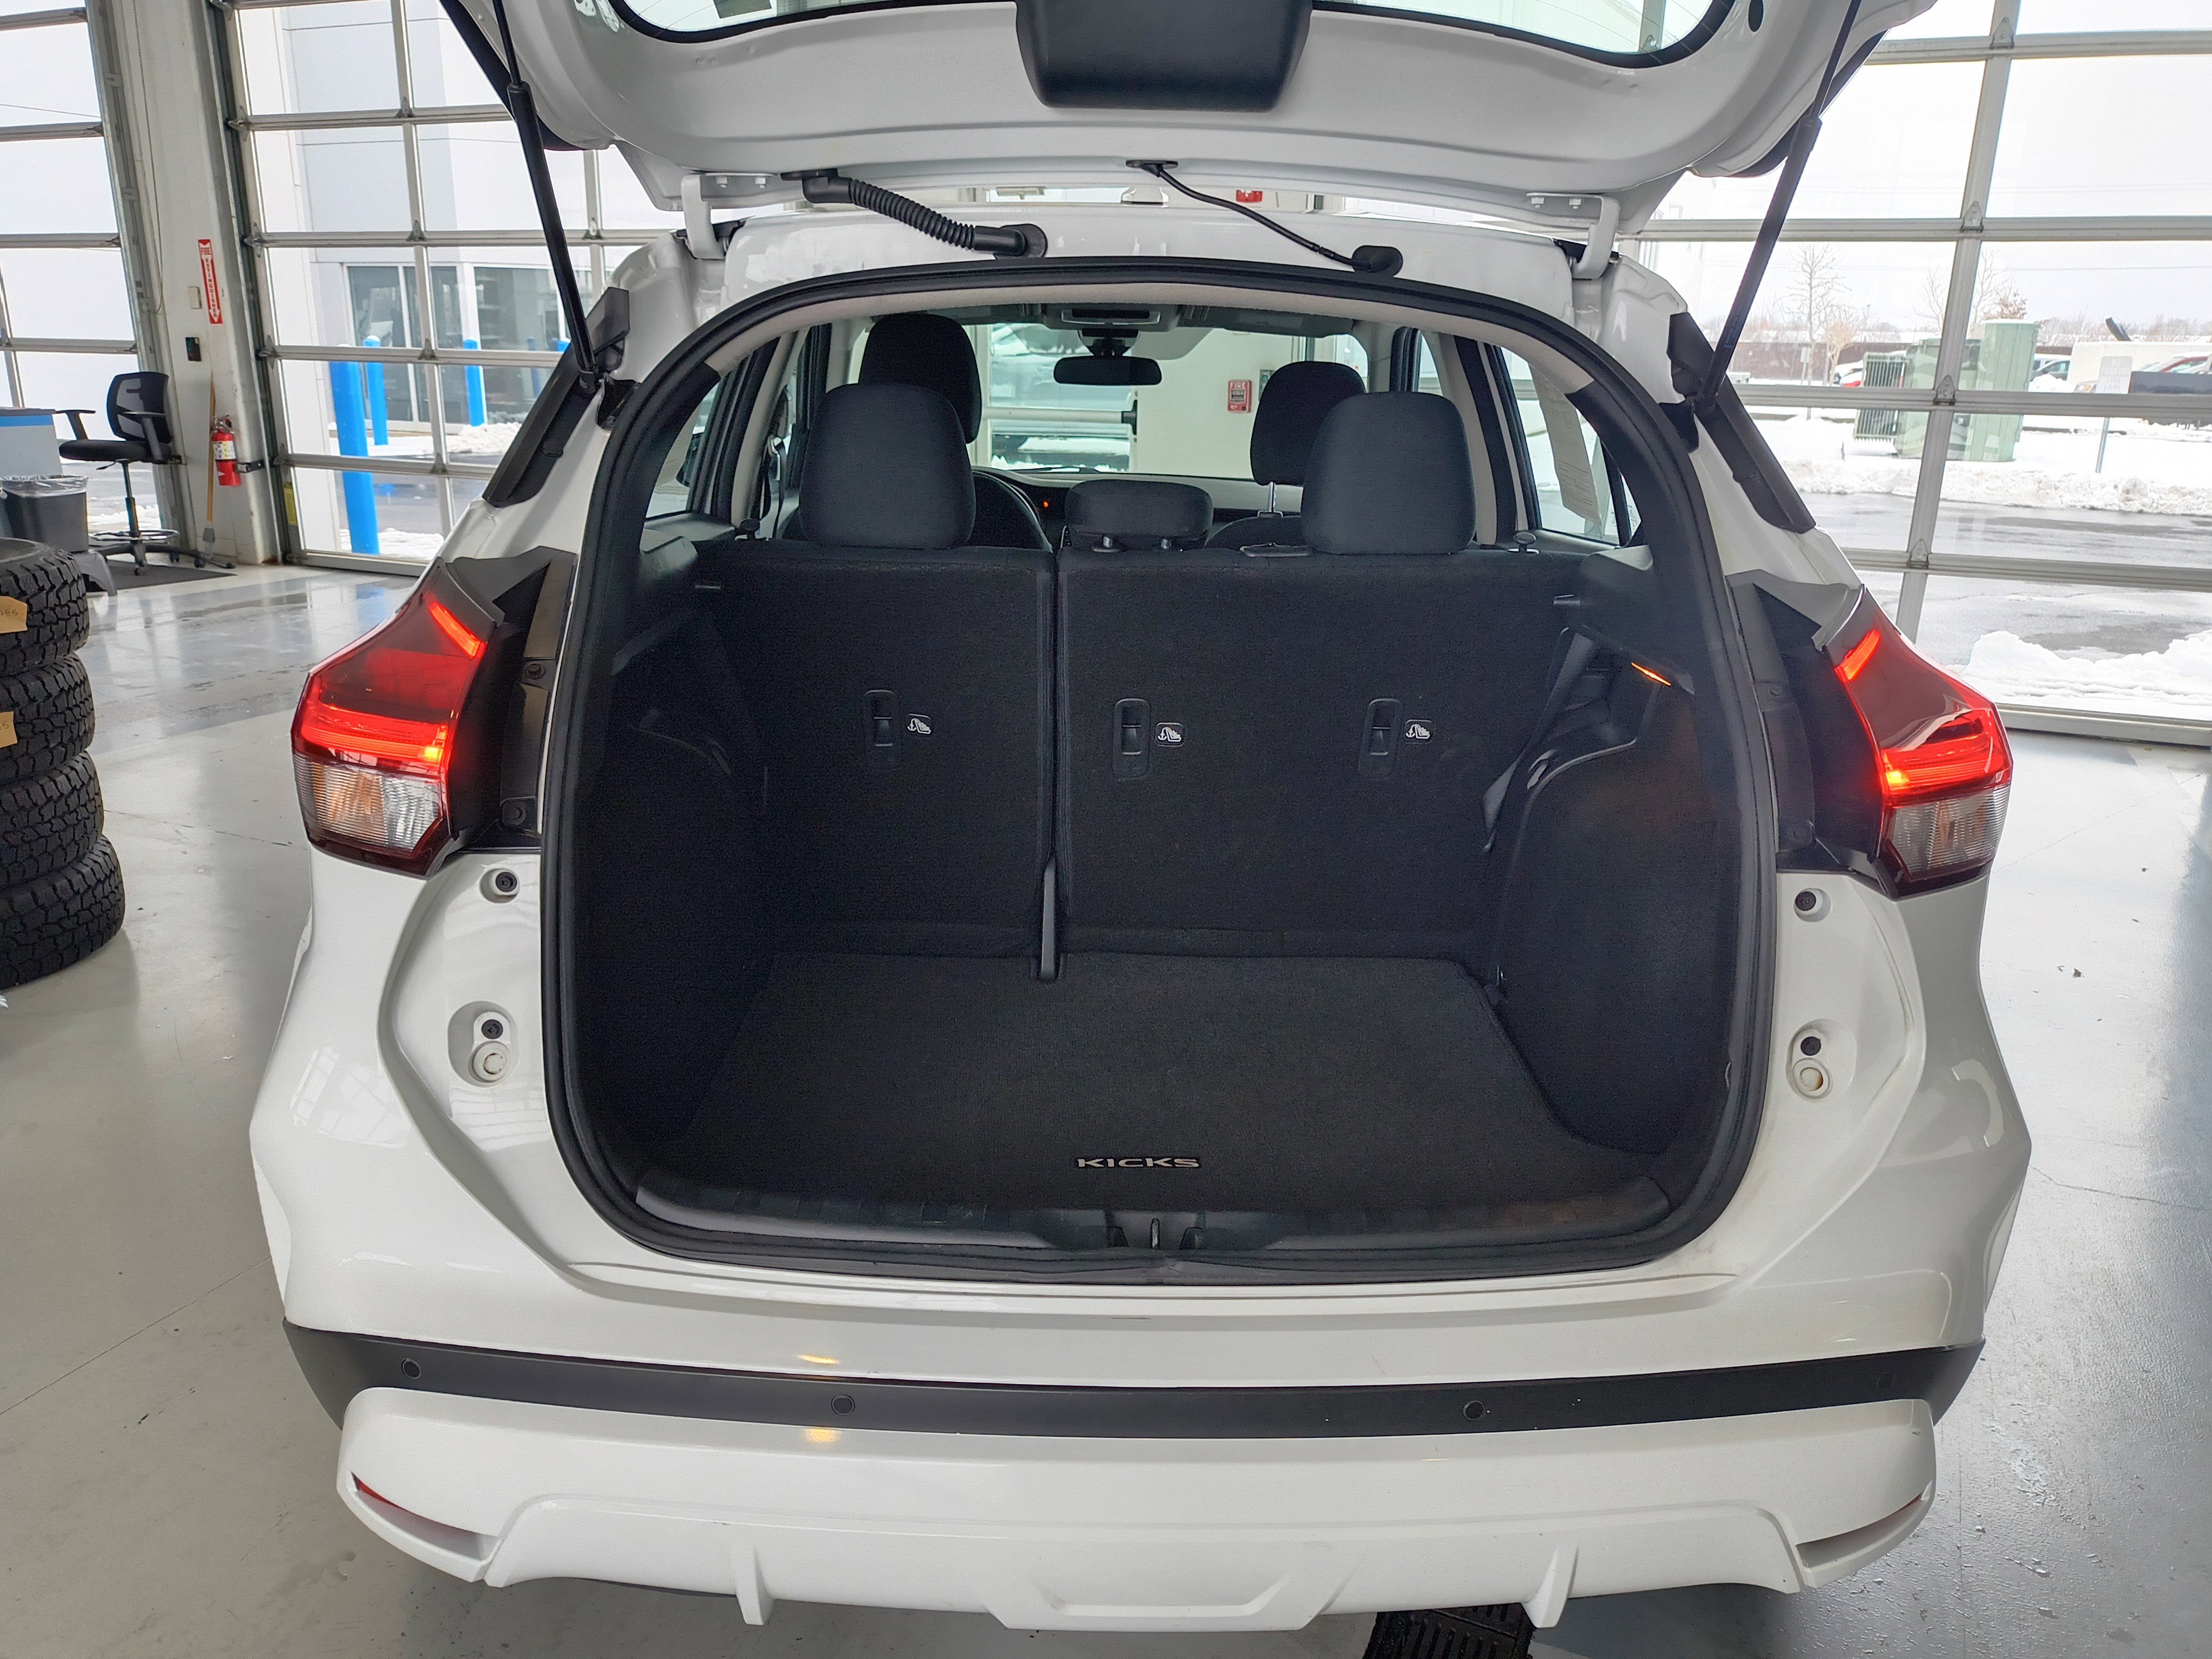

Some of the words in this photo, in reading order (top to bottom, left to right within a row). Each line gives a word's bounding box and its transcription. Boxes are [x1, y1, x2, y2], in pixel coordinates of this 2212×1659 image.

[205, 258, 217, 318] EXTINGUISHER
[2100, 367, 2130, 375] PARKING
[1077, 1157, 1200, 1168] KICKS
